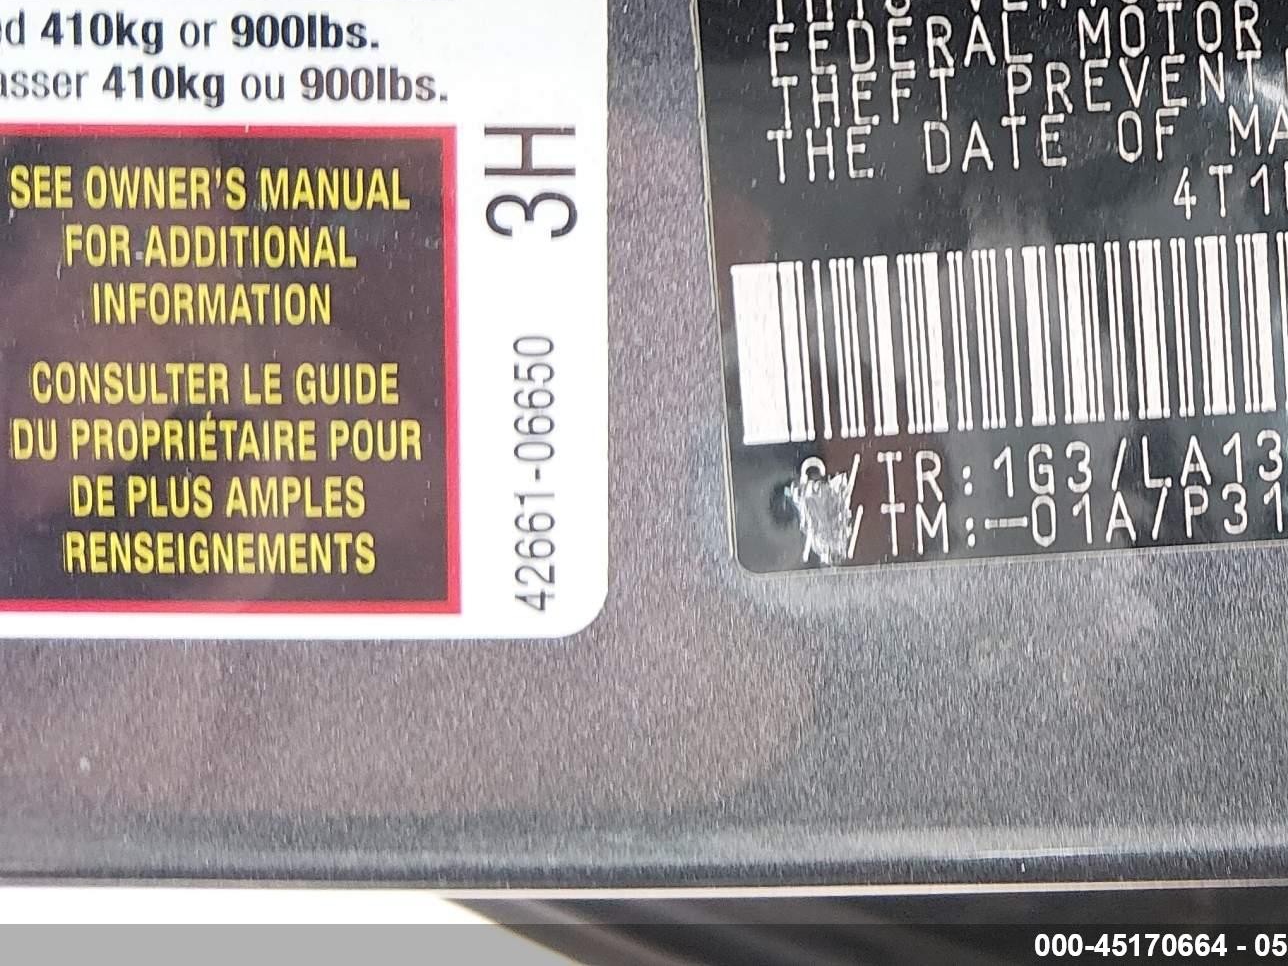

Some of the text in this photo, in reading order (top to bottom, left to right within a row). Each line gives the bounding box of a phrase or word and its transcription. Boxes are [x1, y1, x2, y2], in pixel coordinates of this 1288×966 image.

[40, 10, 164, 57] 410kg
[179, 19, 219, 49] or
[230, 13, 381, 51] 900lbs.
[767, 9, 1034, 79] FEDERAL
[102, 64, 226, 110] 410kg
[240, 71, 287, 102] ou
[300, 66, 449, 104] 900lbs.
[771, 67, 955, 131] THEFT
[767, 124, 875, 184] THE
[923, 113, 1068, 175] DATE
[1117, 107, 1180, 164] OF
[9, 164, 411, 211] SEE OWNER'S MANUAL
[483, 125, 579, 238] 3H
[64, 223, 358, 269] FOR ADDITIONAL
[91, 282, 332, 326] INFORMATION
[31, 362, 400, 406] CONSULTER LE GUIDE
[10, 410, 422, 463] DU PROPRIÉTAIRE POUR
[512, 334, 556, 612] 42661-06650
[71, 476, 366, 519] DE PLUS AMPLES
[63, 532, 377, 575] RENSEIGNEMENTS
